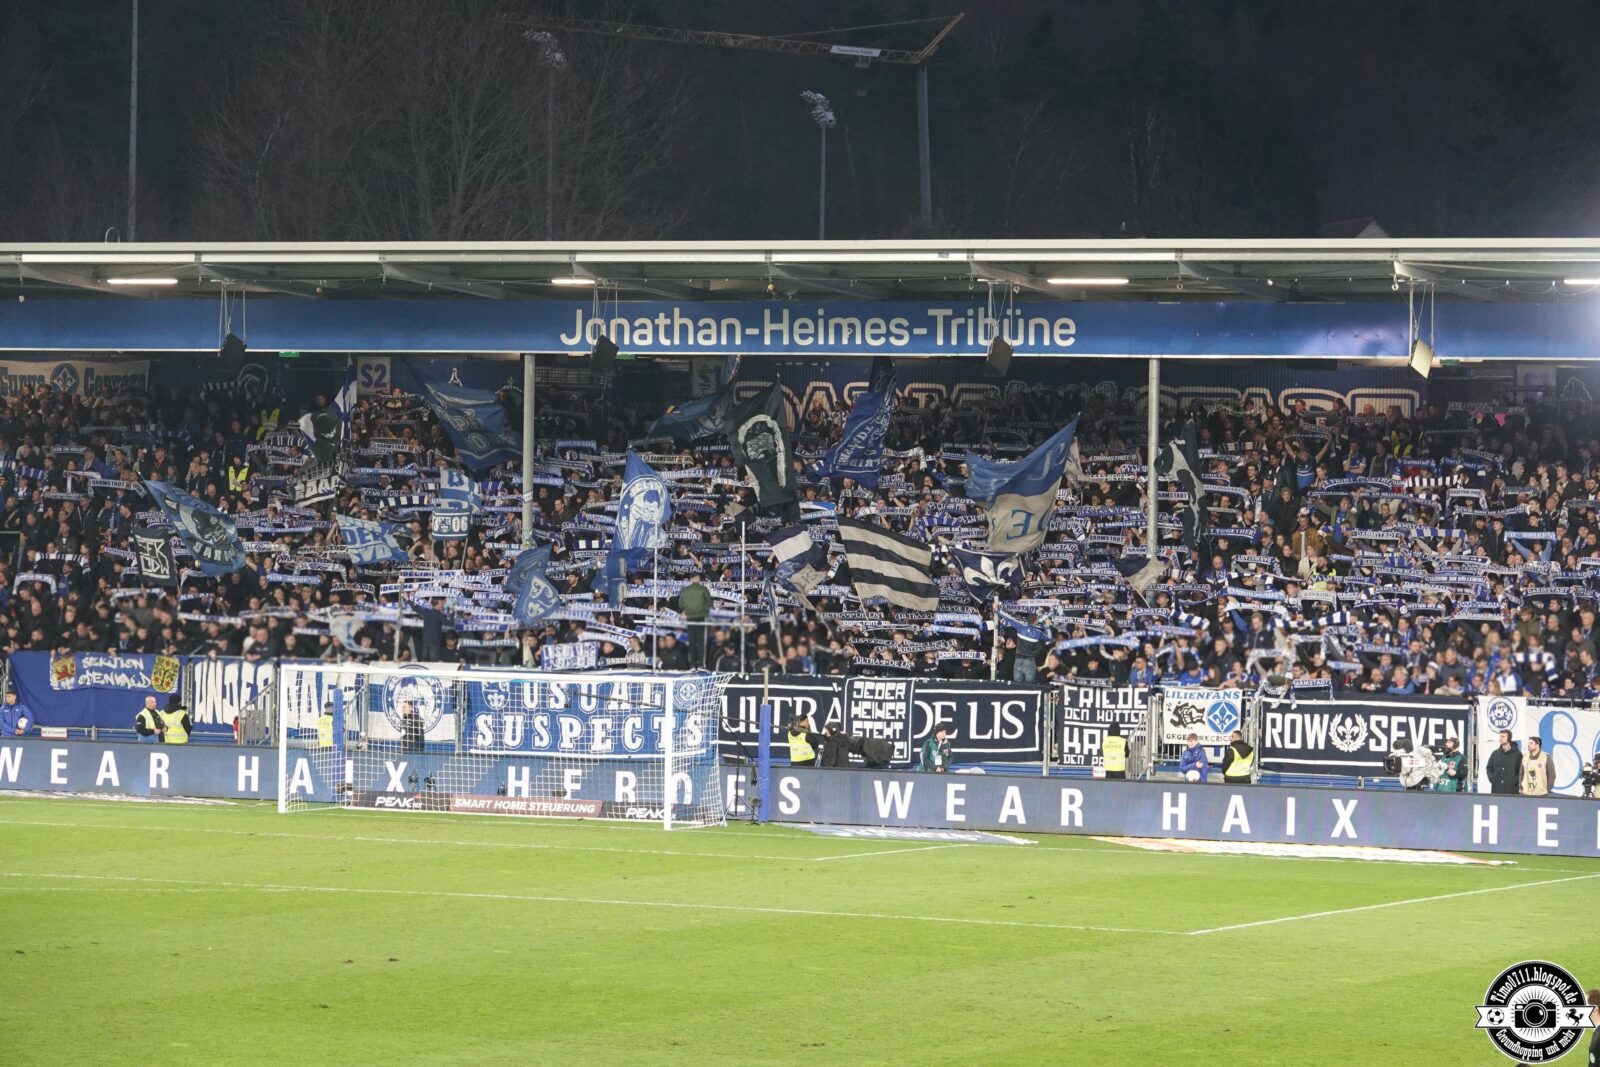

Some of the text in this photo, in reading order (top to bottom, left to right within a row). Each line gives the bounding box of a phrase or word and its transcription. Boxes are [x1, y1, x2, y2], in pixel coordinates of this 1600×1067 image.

[559, 307, 1077, 347] Jonathan-Heimes-Tribüne
[361, 363, 388, 389] S2
[523, 680, 662, 713] USUAL
[852, 681, 907, 700] JEDER
[1063, 686, 1149, 709] FRIEDE
[1165, 690, 1241, 701] LILIENFANS
[967, 700, 1026, 740] LIS
[1064, 707, 1090, 721] DEN
[475, 714, 704, 751] SUSPECTS
[852, 721, 904, 740] STEHT
[1265, 711, 1464, 755] ROW SEVEN
[0, 746, 170, 789] WEAR
[237, 755, 408, 797] HAIX
[873, 780, 1084, 828] WEAR
[1162, 791, 1359, 839] HAIX
[1472, 804, 1600, 850] HE
[454, 799, 596, 814] SMART HOME STEUERUNG
